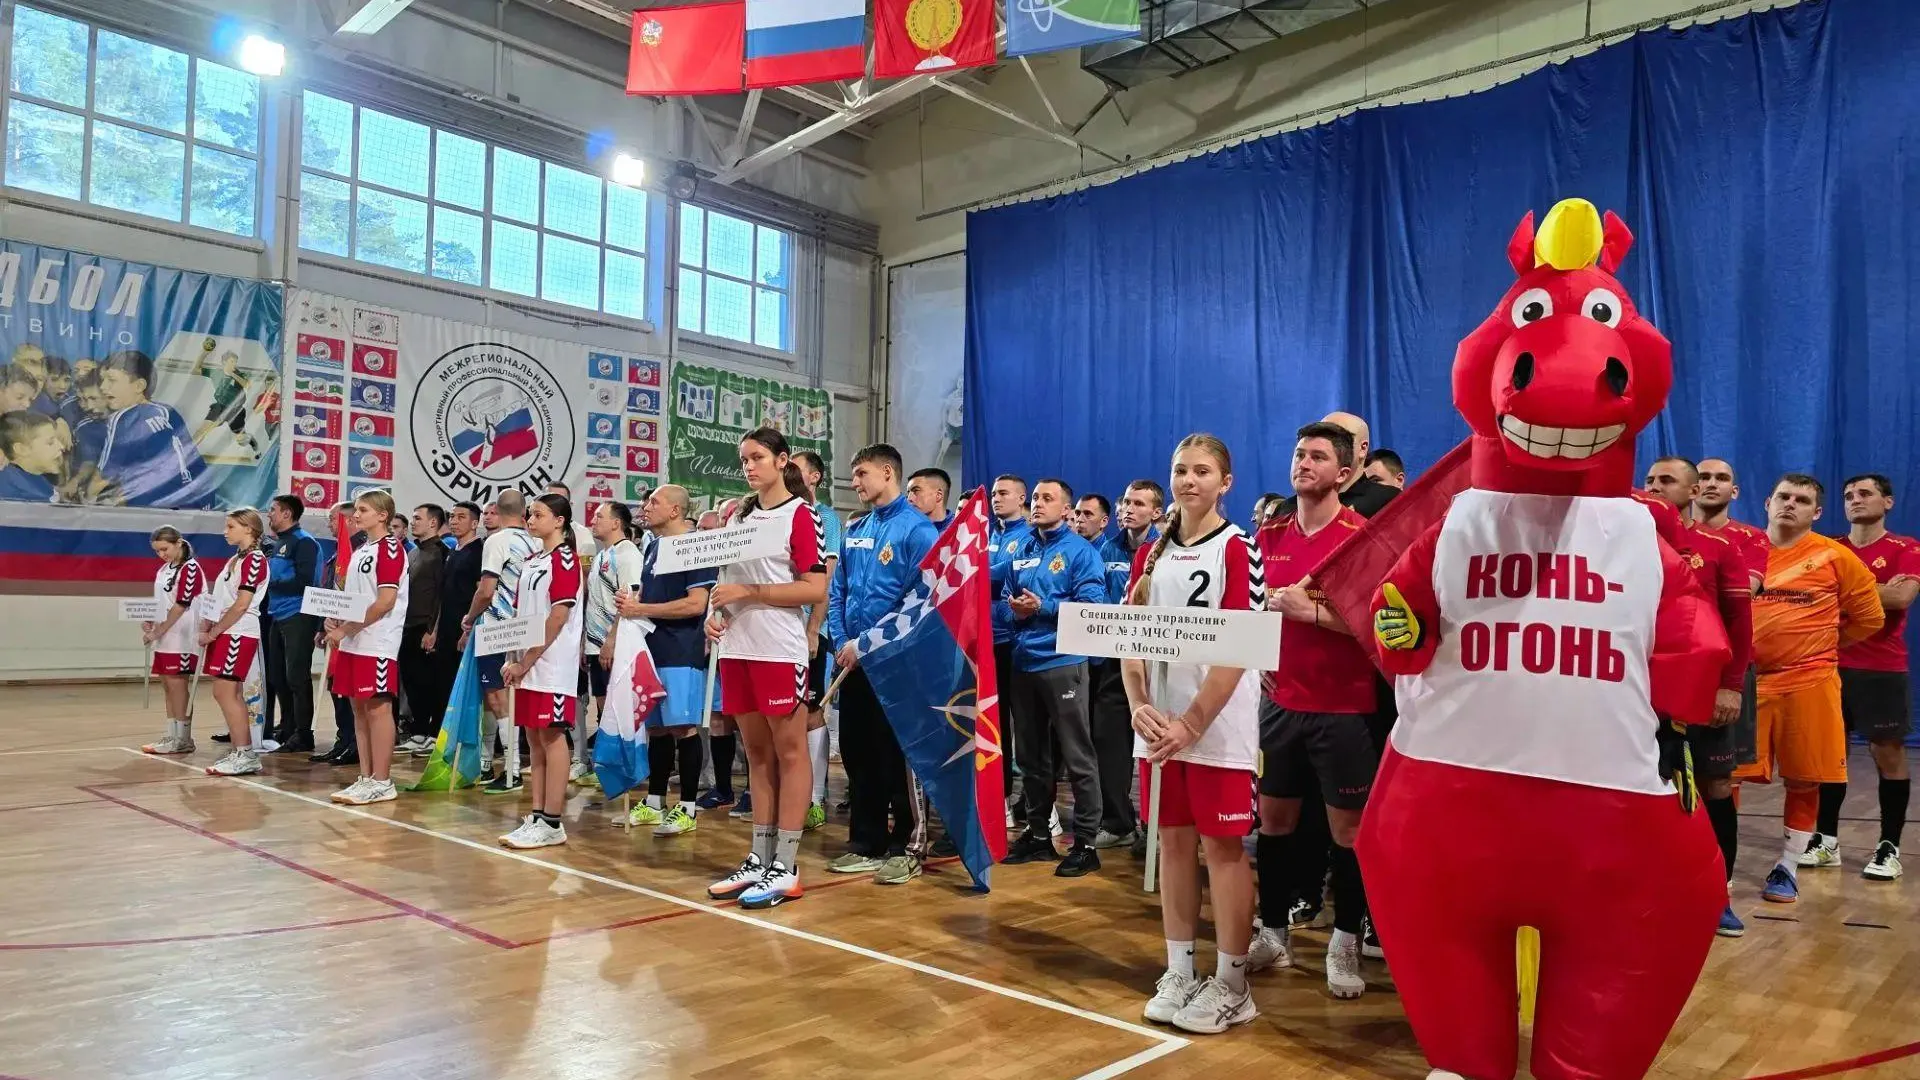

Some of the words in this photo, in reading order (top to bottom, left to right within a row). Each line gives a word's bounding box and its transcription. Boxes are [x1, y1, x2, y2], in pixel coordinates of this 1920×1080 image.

[438, 353, 555, 400] МЕЖРЕГИОНАЛЬНЫЙ
[436, 390, 451, 448] СПОРТИВНЫЙ
[447, 366, 529, 392] ПРОФЕССИОНАЛЬНЫЙ
[528, 385, 544, 404] КЛУБ
[541, 404, 554, 462] ЕДИНОБОРСТВ
[432, 454, 553, 505] ЭРИАН
[672, 534, 717, 547] Специальное
[719, 526, 758, 540] управление
[675, 547, 693, 556] ФПС
[710, 541, 728, 552] МЧС
[728, 538, 752, 548] России
[1171, 553, 1201, 561] hummel
[358, 555, 374, 574] 18
[693, 551, 741, 564] Новоуральск)
[527, 569, 548, 591] 17
[1186, 569, 1211, 607] 2
[1466, 552, 1624, 604] КОНЬ-
[1080, 608, 1152, 622] Специальное
[1156, 613, 1227, 626] управление
[1086, 624, 1114, 636] ФПС
[1116, 626, 1128, 636] №
[1131, 626, 1137, 637] 3
[1141, 626, 1171, 638] МЧС
[1175, 629, 1216, 642] России
[1115, 642, 1127, 654] (г.
[1130, 642, 1180, 657] Москва)
[1460, 621, 1626, 683] ОГОНЬ
[1218, 812, 1251, 822] hummel
